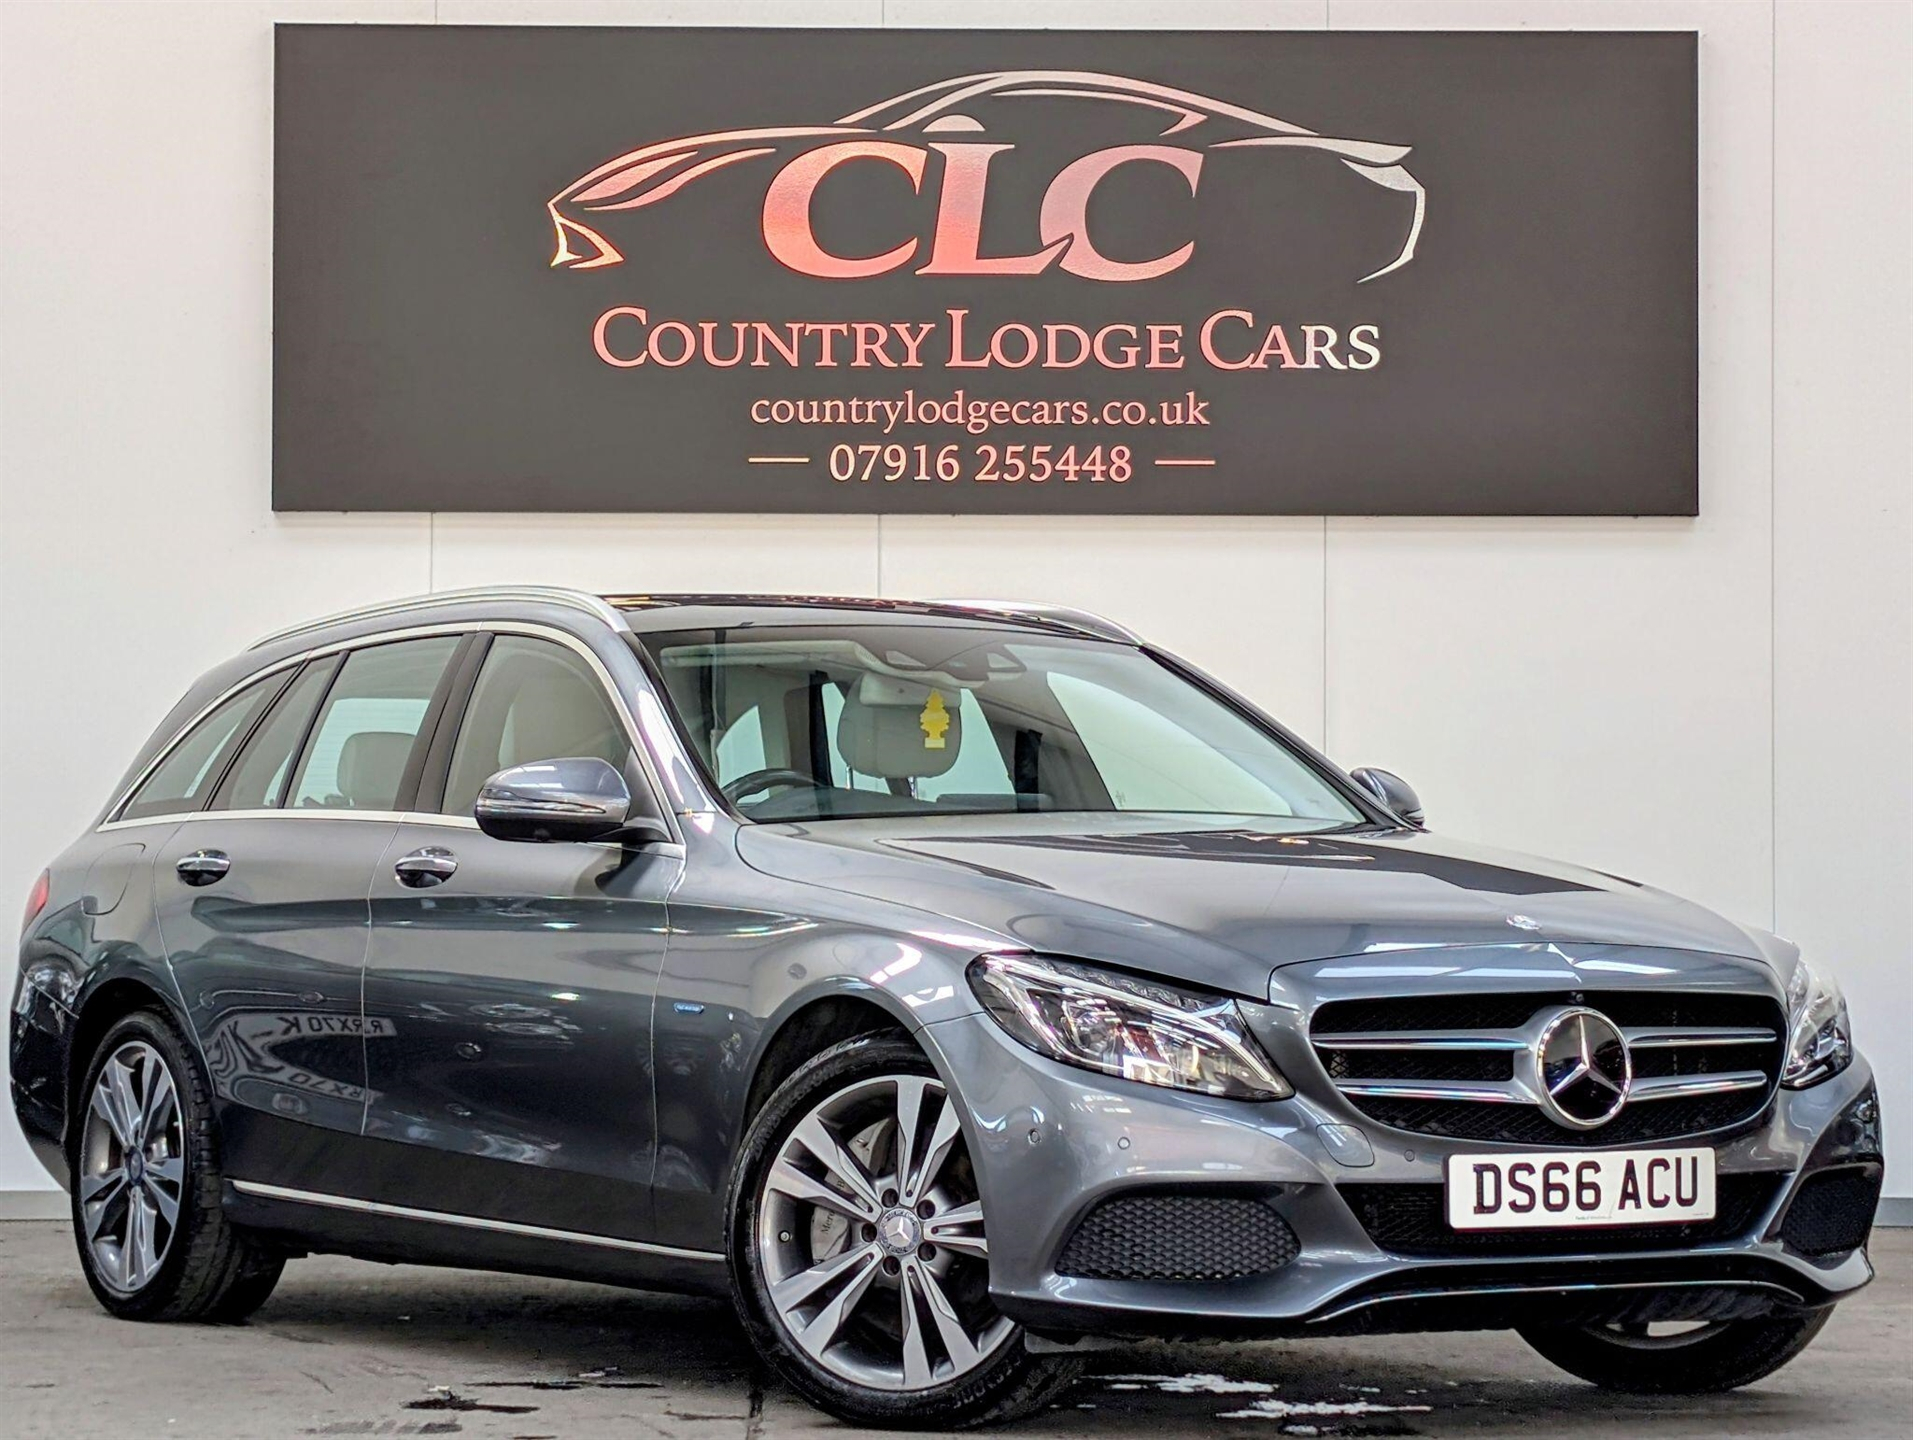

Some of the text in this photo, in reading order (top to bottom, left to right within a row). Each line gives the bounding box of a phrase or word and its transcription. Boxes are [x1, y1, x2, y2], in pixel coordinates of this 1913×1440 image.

[762, 140, 1205, 282] CLC
[749, 389, 1211, 435] countrylodgecars.co.uk
[828, 443, 1133, 483] 07916 255448
[1472, 1155, 1699, 1216] DS66 ACU
